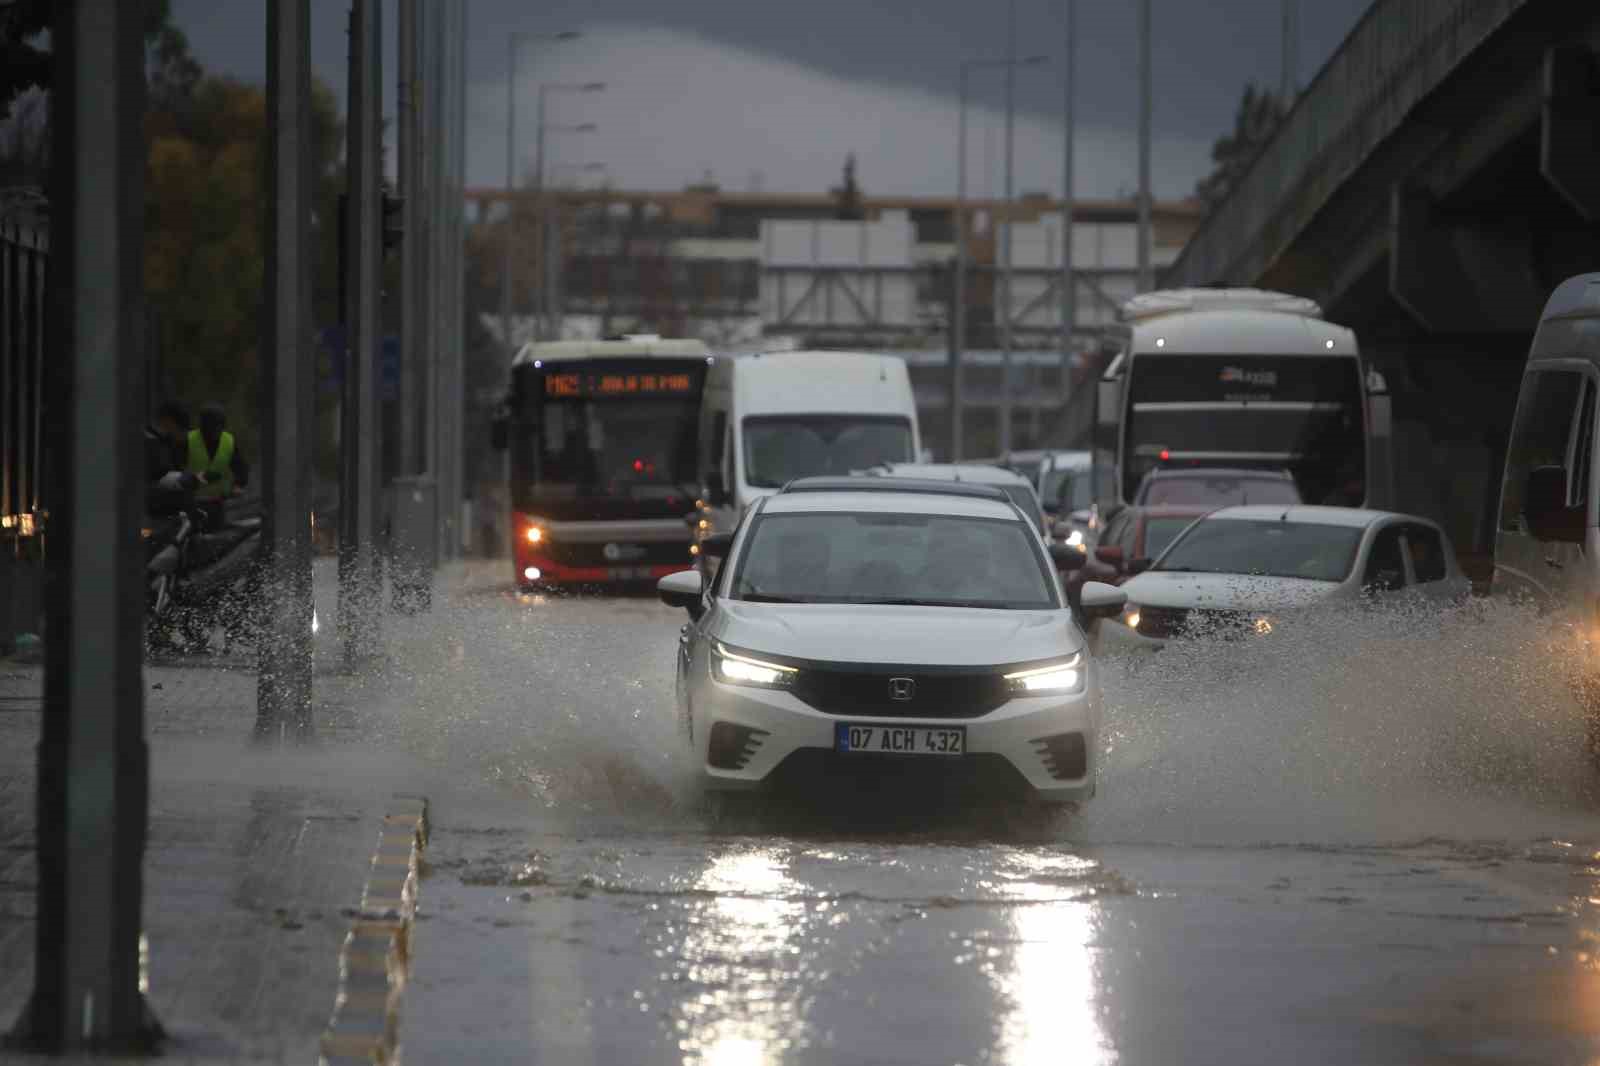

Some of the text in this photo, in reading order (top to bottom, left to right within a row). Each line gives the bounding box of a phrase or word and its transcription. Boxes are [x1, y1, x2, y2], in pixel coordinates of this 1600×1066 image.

[850, 728, 961, 753] 07 ACH 432
